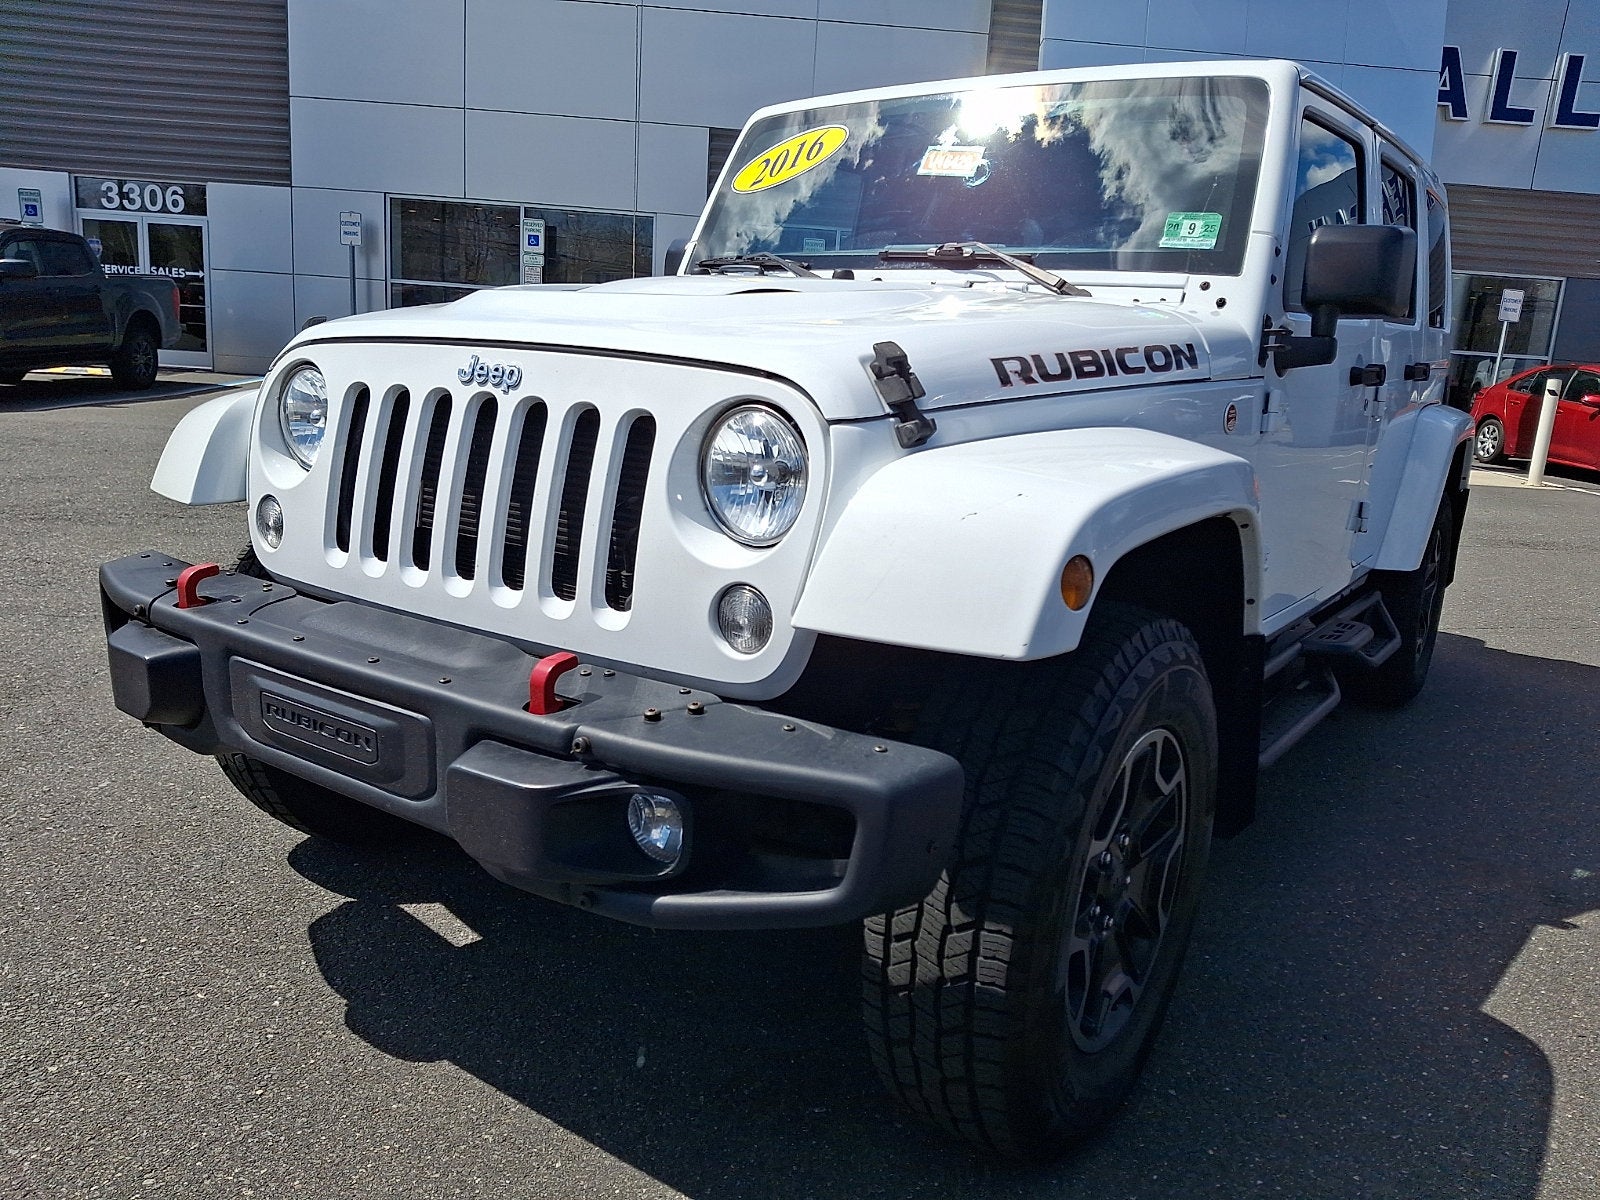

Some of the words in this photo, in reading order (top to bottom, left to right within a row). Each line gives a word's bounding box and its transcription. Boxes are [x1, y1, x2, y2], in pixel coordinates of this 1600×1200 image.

[749, 129, 830, 188] 2016
[101, 181, 185, 213] 3306
[1167, 223, 1180, 231] 20
[1188, 222, 1197, 235] 9
[1203, 224, 1217, 233] 25
[150, 266, 186, 278] SALES
[458, 354, 523, 396] Jeep
[989, 343, 1199, 388] RUBICON
[265, 702, 373, 752] RUBICON
